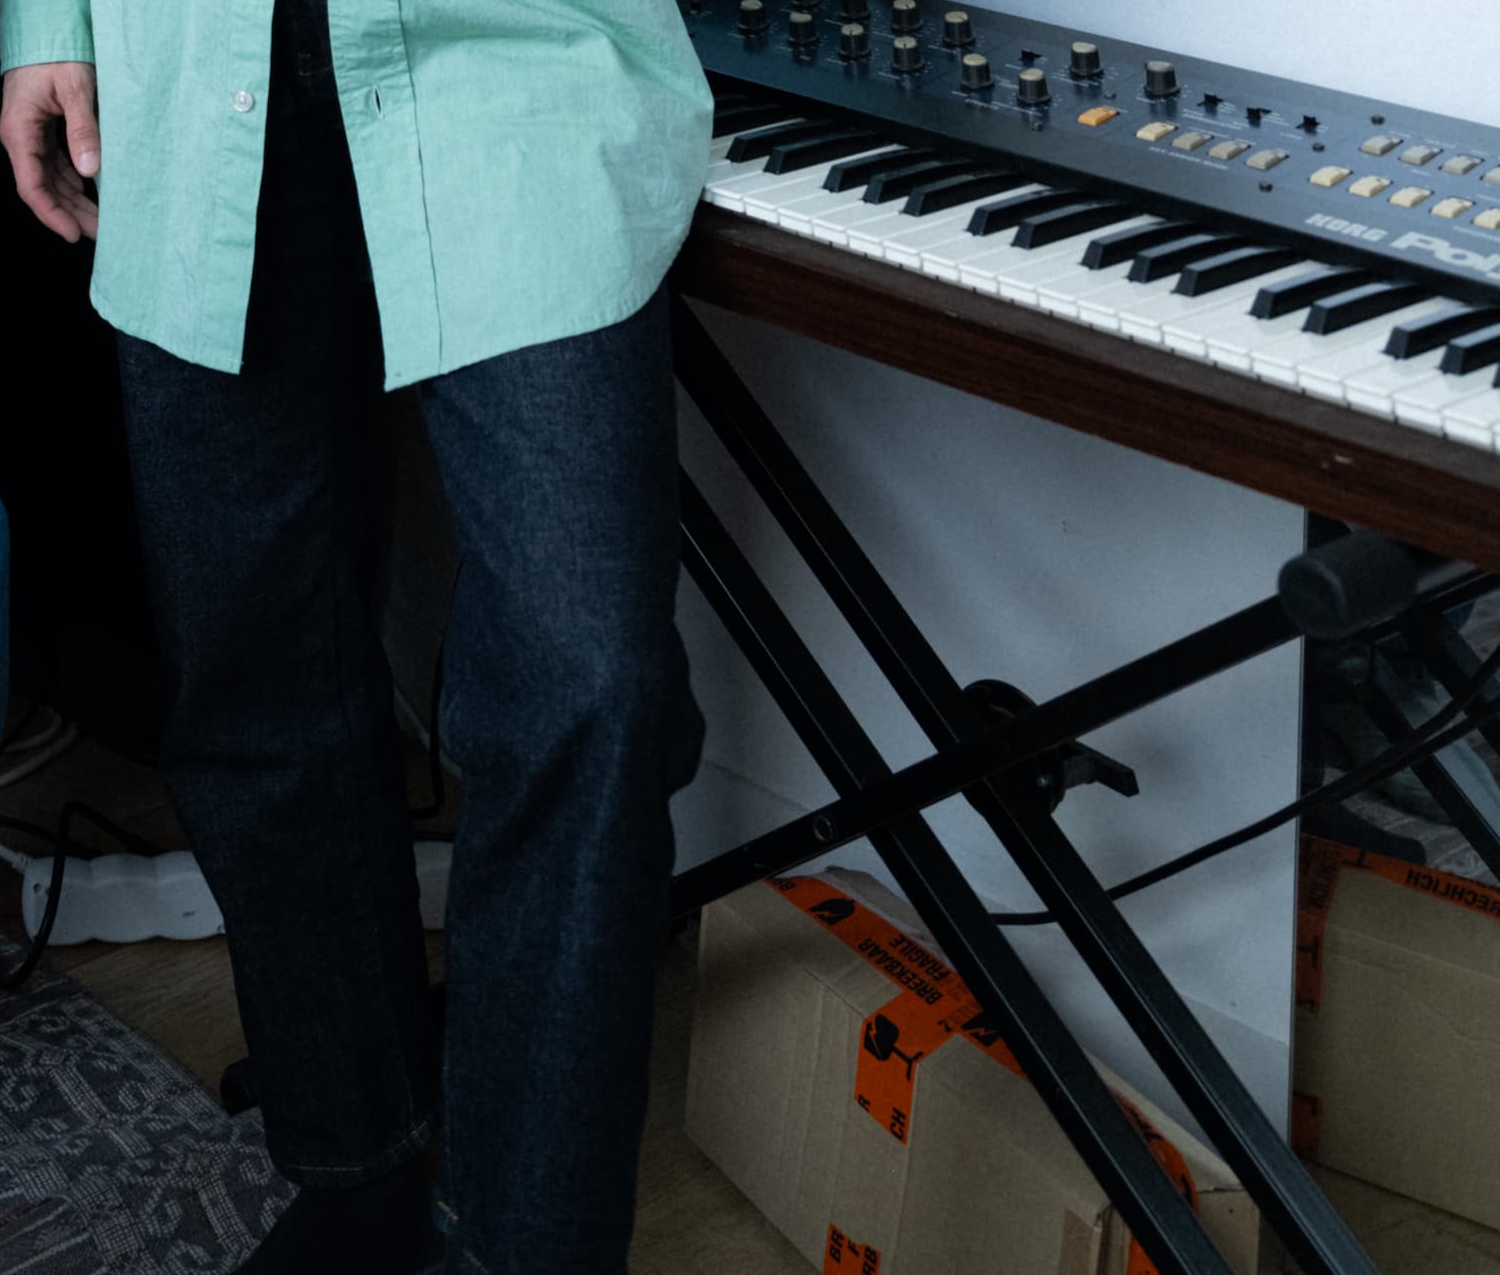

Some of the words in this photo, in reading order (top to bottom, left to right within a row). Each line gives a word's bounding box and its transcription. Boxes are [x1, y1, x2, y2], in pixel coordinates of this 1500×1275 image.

[1304, 212, 1389, 243] KORG
[858, 938, 943, 1004] BREEKBAAR
[889, 935, 950, 981] FRAGILE
